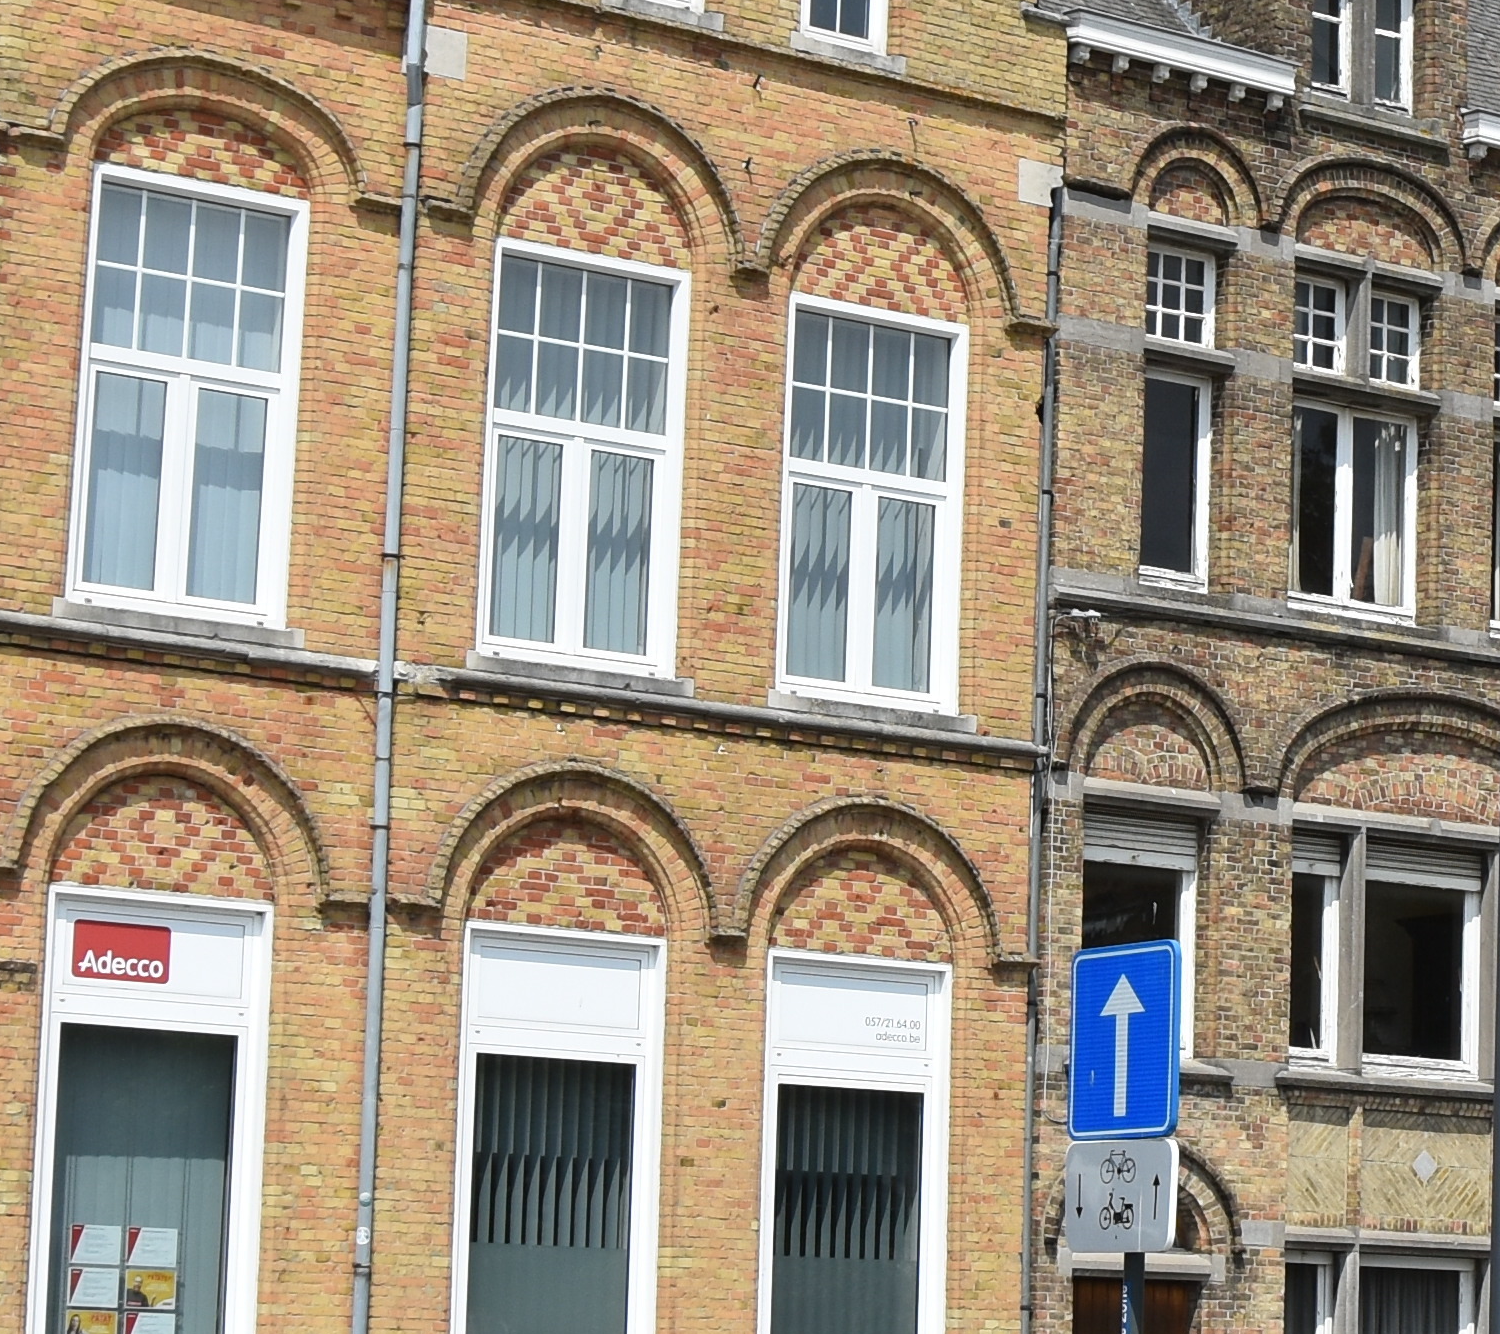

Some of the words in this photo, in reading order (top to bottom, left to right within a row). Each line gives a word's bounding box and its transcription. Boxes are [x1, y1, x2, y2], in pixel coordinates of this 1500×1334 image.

[77, 949, 164, 978] Adecco
[864, 1016, 921, 1030] 057/21.64.00
[875, 1031, 921, 1044] adecco.be
